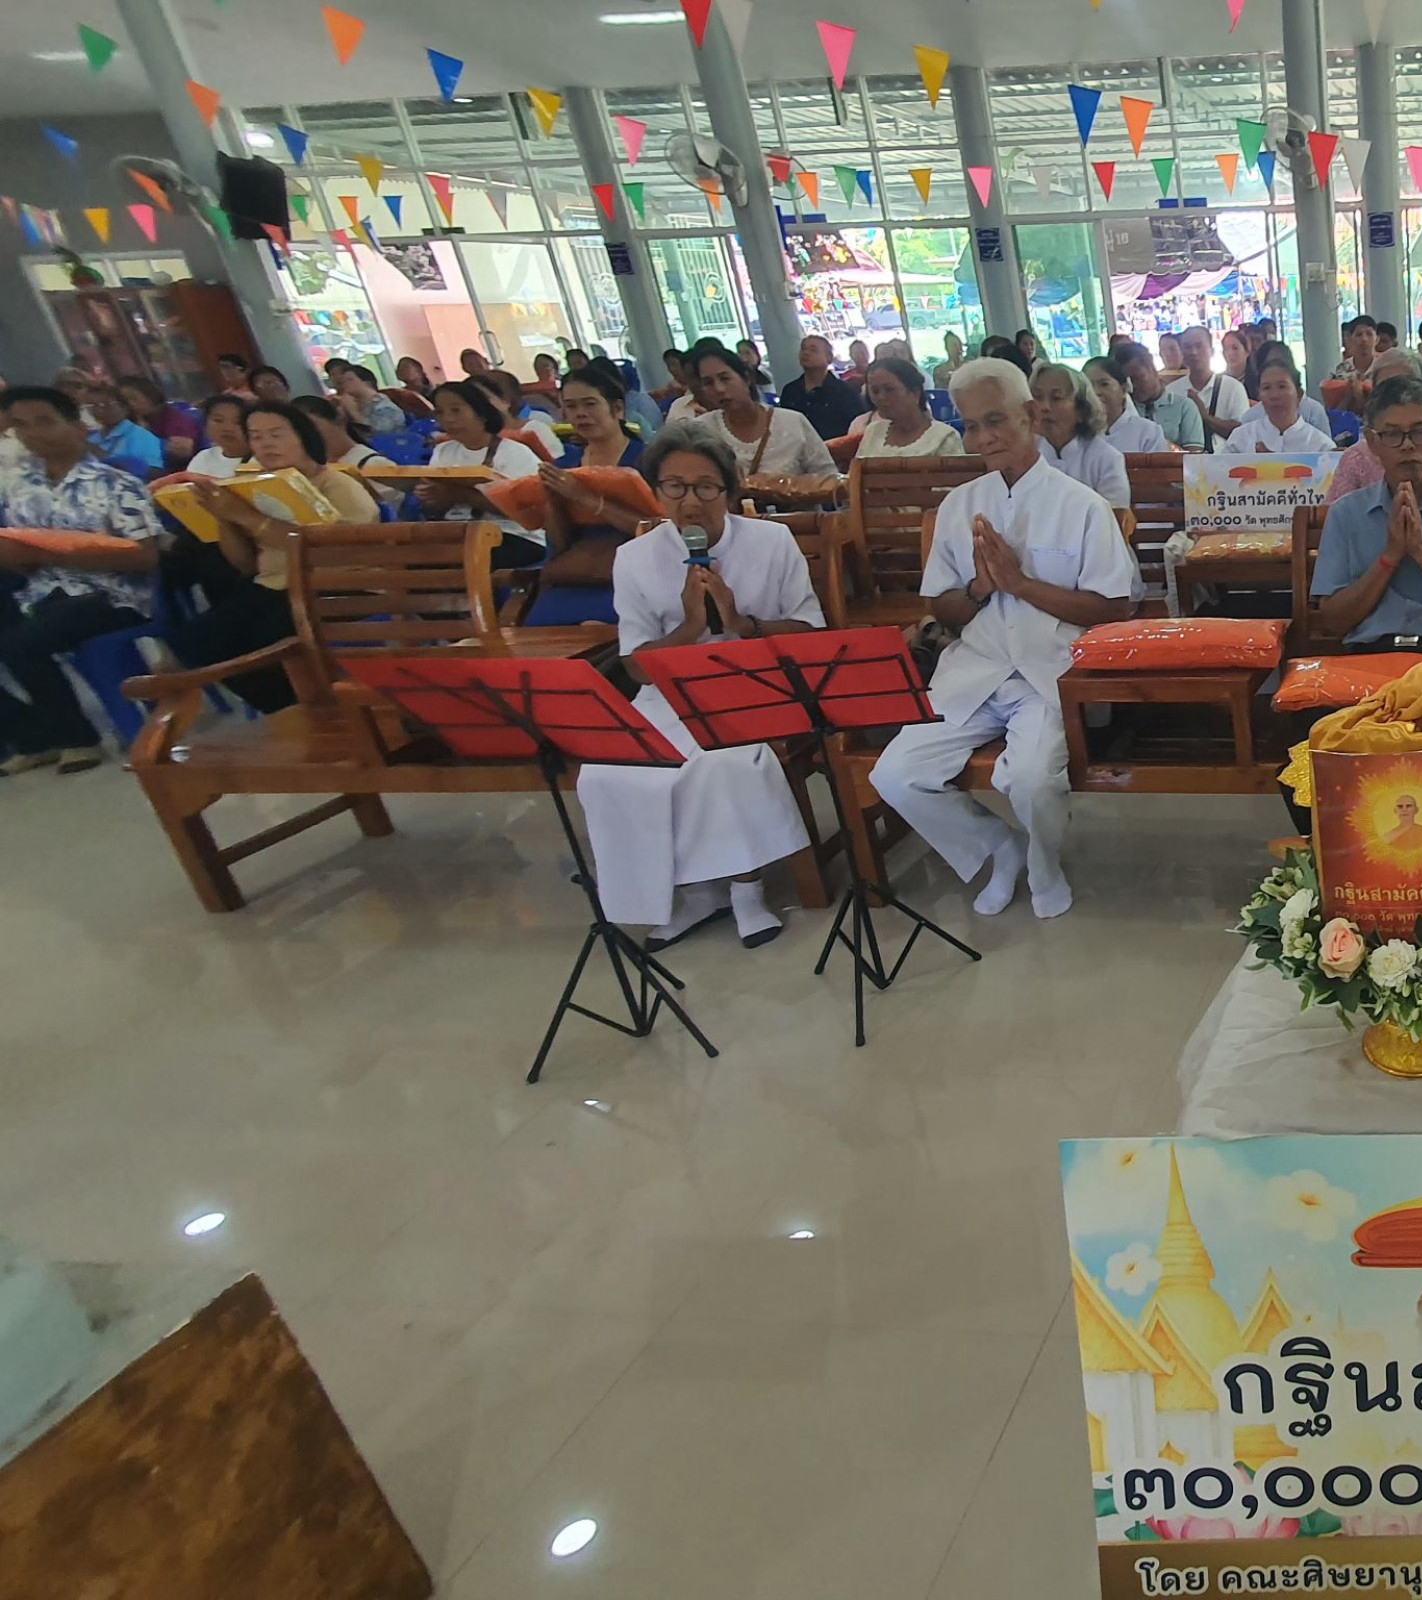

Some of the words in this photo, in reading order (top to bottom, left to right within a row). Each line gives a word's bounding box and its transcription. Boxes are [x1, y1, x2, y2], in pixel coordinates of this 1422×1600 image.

[1207, 485, 1325, 511] กฐินสามัคคีทั่วไท
[1190, 515, 1242, 527] ๓๐,๐๐๐
[1244, 514, 1257, 525] วัด
[1259, 513, 1294, 528] พุทธศัก
[1139, 1558, 1205, 1592] โดย
